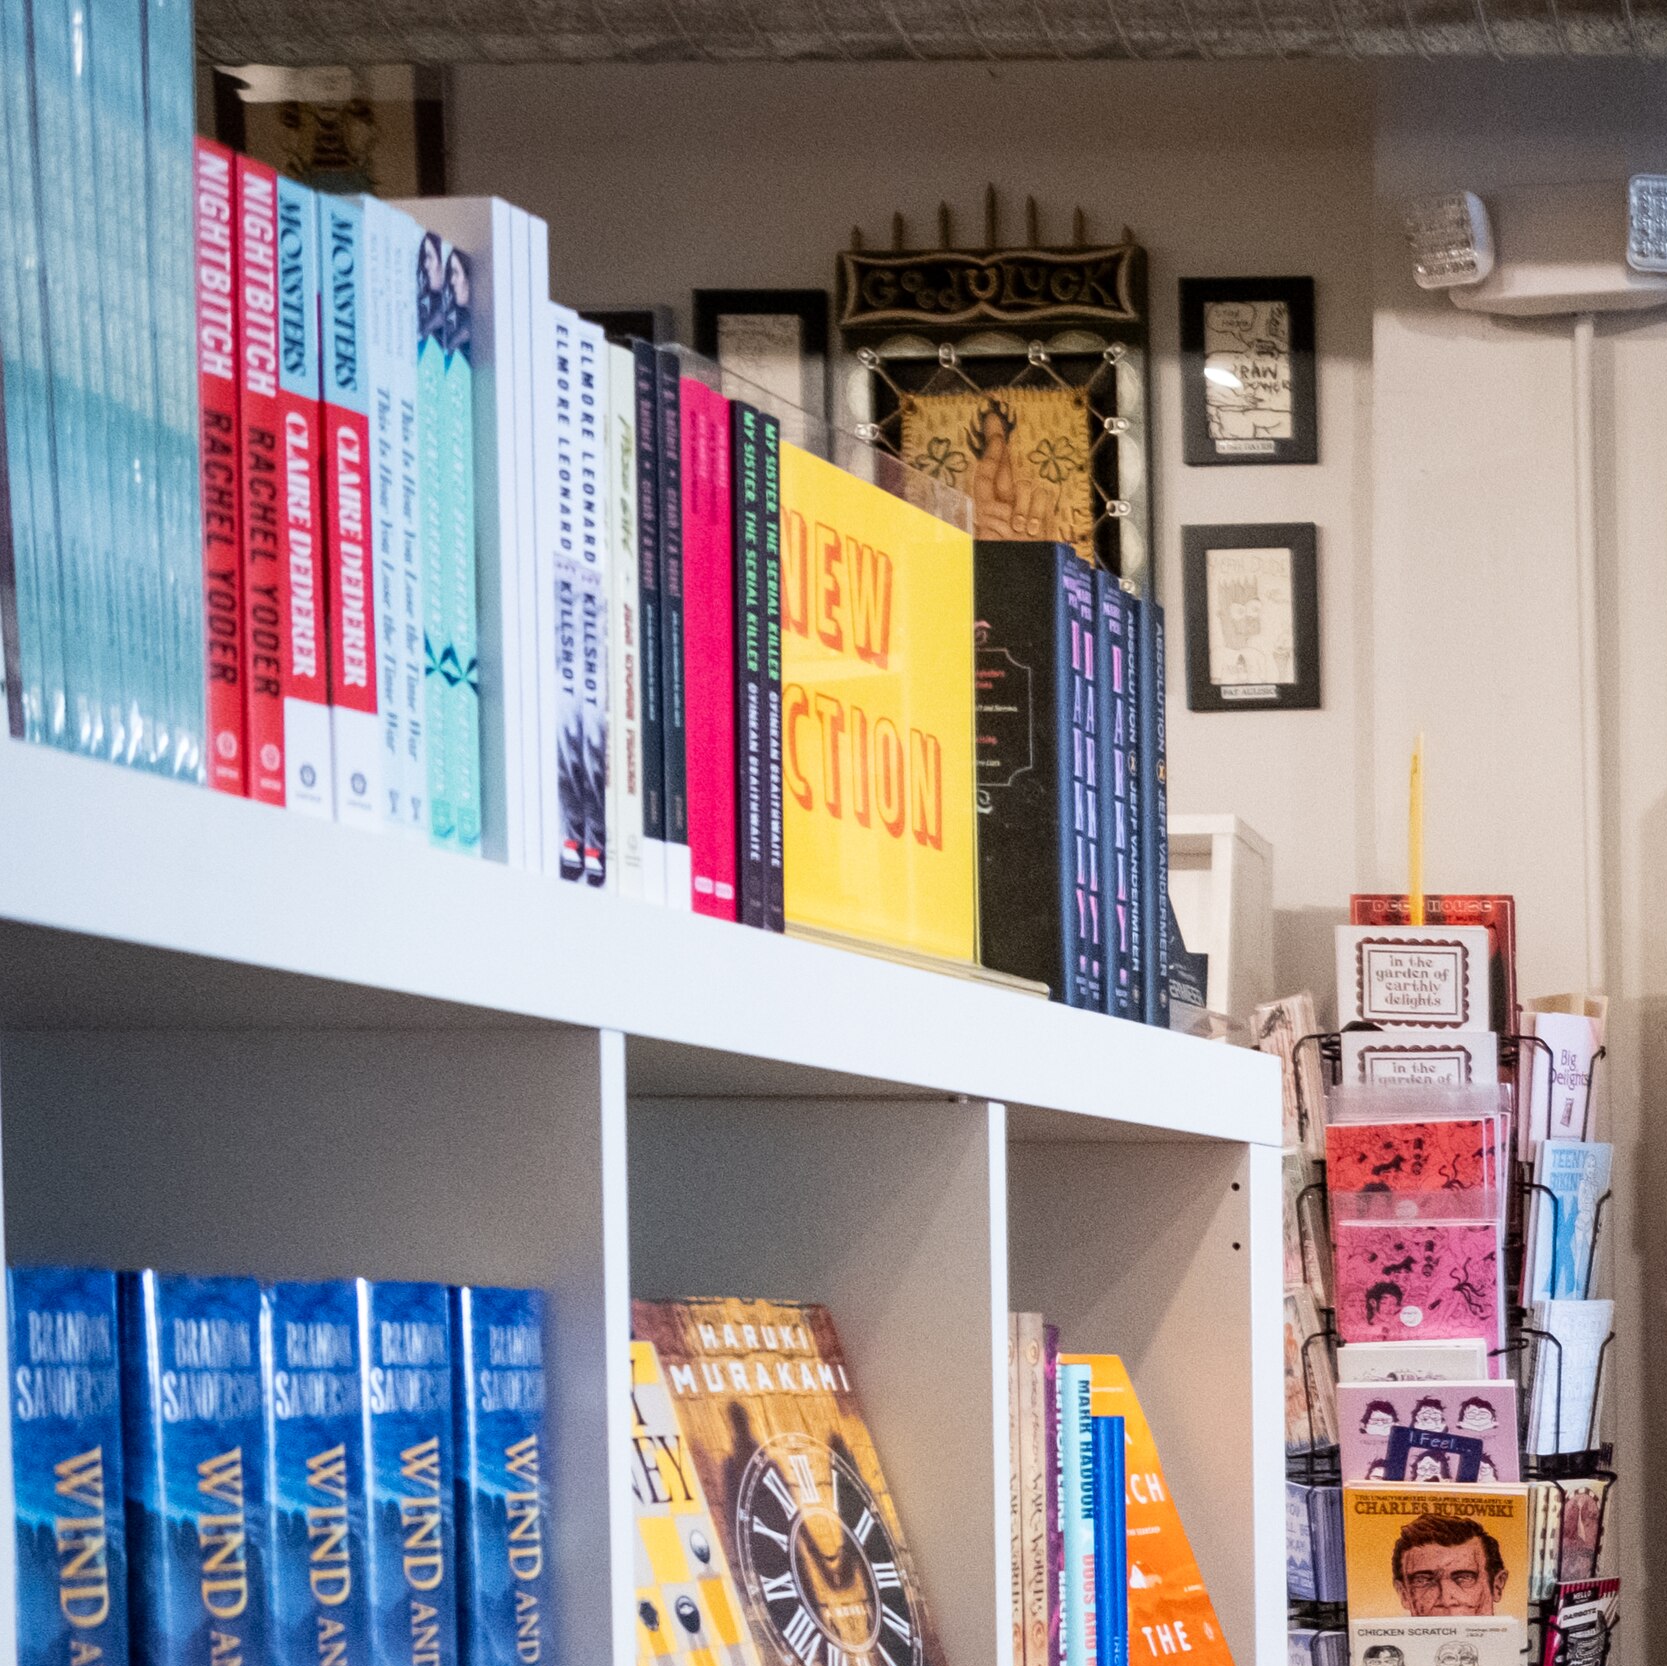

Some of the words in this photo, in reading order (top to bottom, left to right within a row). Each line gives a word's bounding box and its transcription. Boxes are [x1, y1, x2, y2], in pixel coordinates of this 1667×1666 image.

[198, 153, 233, 380] NIGHTBITCH
[244, 173, 277, 397] NIGHTBITCH
[280, 196, 306, 376] MONSTERS
[330, 213, 357, 391] MONSTERS
[555, 325, 571, 424] ELMORE
[203, 410, 236, 546] RACHEL
[285, 411, 311, 527] CLAIRE
[336, 426, 363, 536] CLAIRE
[765, 423, 778, 454] MY
[248, 426, 280, 563] RACHEL
[558, 438, 573, 550] LEONARD
[767, 522, 779, 553] THE
[208, 569, 238, 684] YODER
[288, 528, 317, 677] DEDERER
[339, 538, 367, 686] DEDERER
[767, 560, 780, 616] SERIAL
[252, 582, 281, 699] YODER
[560, 581, 575, 696] KILLSHOT
[767, 622, 780, 681] KILLER
[1154, 622, 1167, 752] ABSOLUTION
[782, 683, 943, 851] CTION
[1157, 789, 1167, 838] JEFF
[1375, 968, 1431, 982] garden
[1434, 968, 1450, 981] of
[1384, 993, 1441, 1010] delights
[1385, 980, 1441, 995] earthly
[1389, 954, 1404, 967] in
[1409, 955, 1433, 967] the
[1561, 1049, 1577, 1068] Big
[672, 1360, 850, 1396] MURAKAMI
[700, 1320, 810, 1352] HARUKI
[1077, 1379, 1094, 1435] MARK
[1079, 1441, 1095, 1520] HADDON
[1354, 1501, 1431, 1516] CHARLES
[1434, 1503, 1514, 1517] BUKOWSKI
[54, 1446, 109, 1629] WIND
[198, 1447, 248, 1620] WIND
[1081, 1554, 1099, 1605] DOGS
[1084, 1612, 1099, 1649] AND
[1141, 1620, 1192, 1658] THE
[1357, 1628, 1405, 1637] CHICKEN
[1407, 1627, 1457, 1636] SCRATCH
